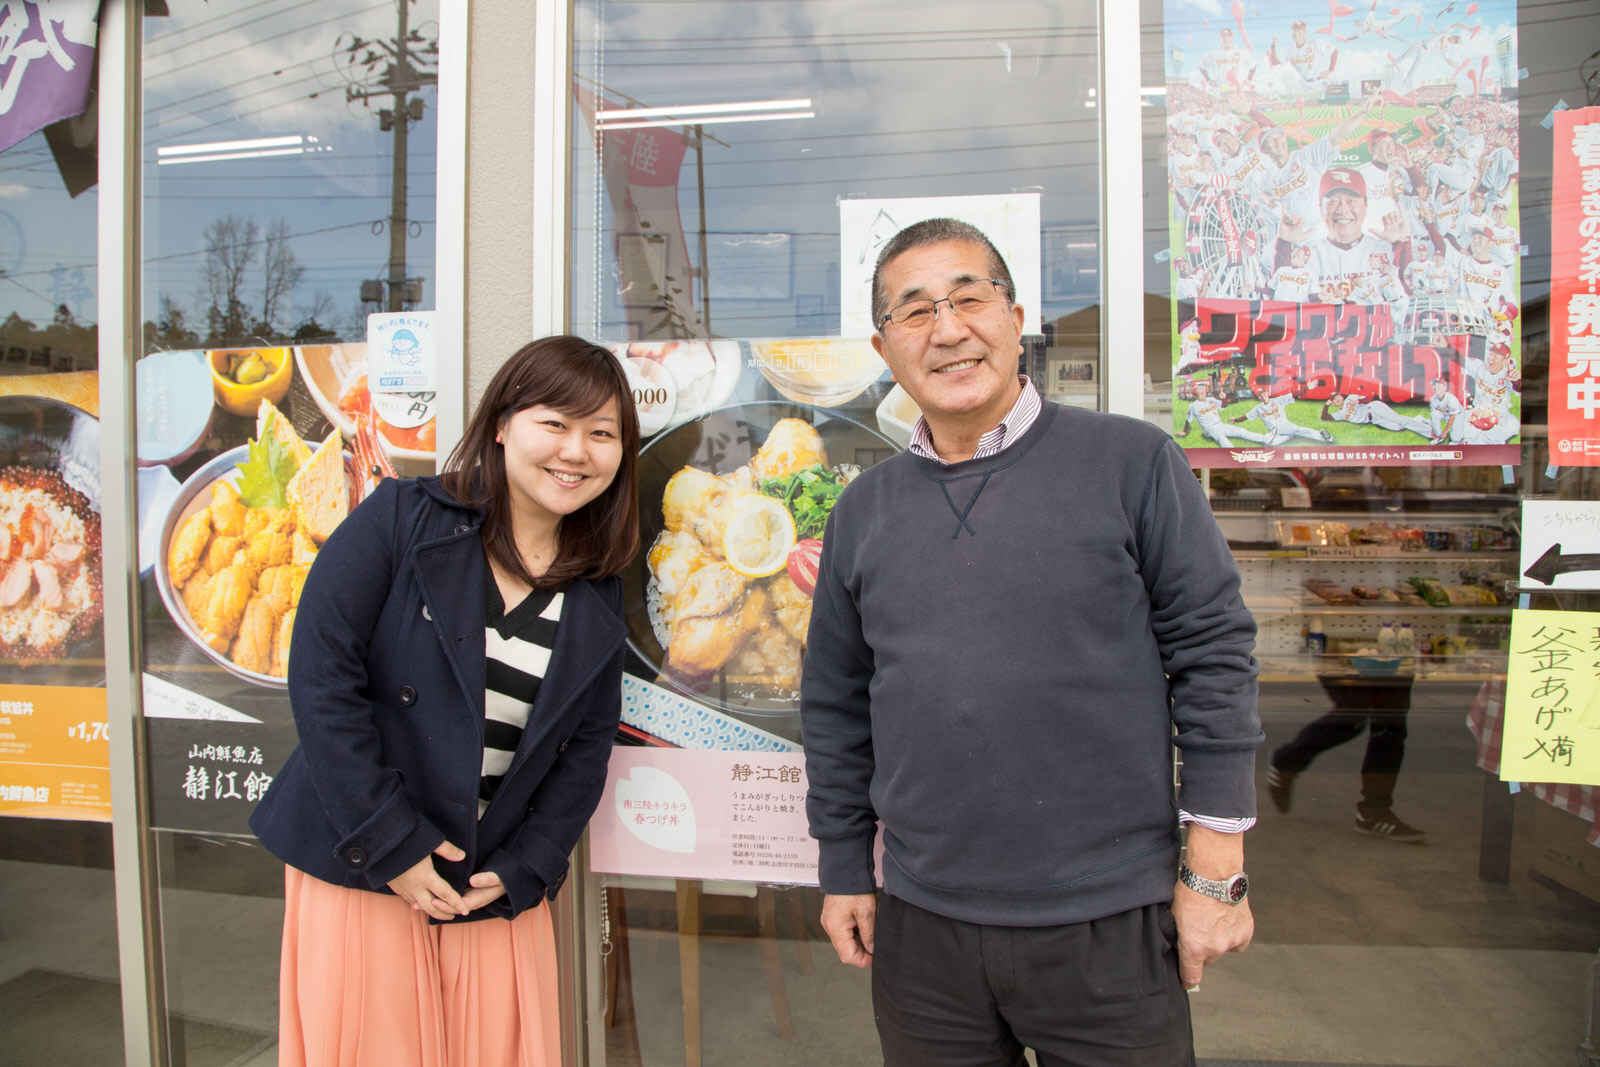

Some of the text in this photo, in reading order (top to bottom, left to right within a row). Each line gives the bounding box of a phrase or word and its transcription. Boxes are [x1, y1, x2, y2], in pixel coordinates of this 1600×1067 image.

[188, 744, 264, 765] 山内鮮魚店
[731, 763, 802, 783] 静江館
[623, 799, 688, 812] 南三陸キラキラ
[634, 812, 681, 827] 春つげ丼
